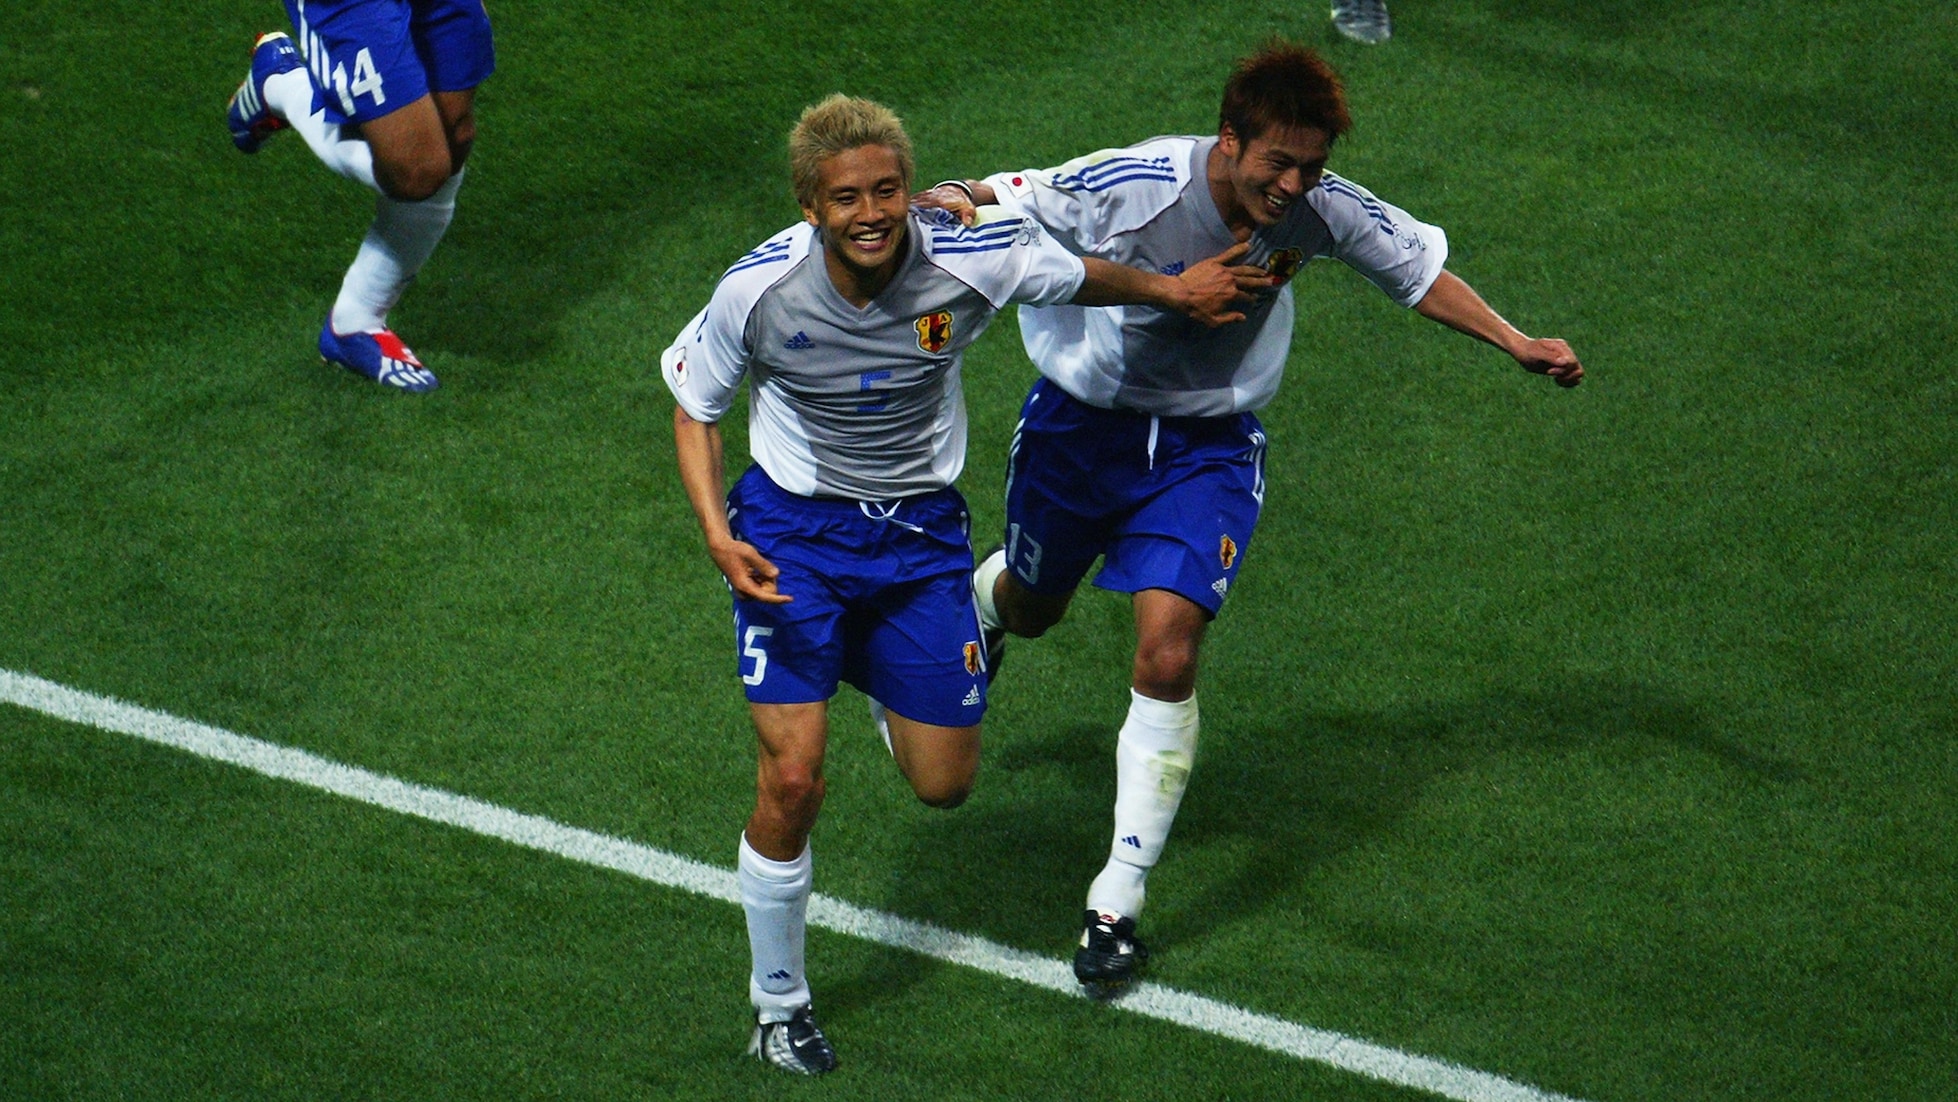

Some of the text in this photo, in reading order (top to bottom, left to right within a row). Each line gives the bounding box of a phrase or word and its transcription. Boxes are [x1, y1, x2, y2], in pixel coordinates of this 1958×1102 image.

[332, 46, 386, 117] 14
[1008, 522, 1043, 585] 13
[742, 625, 774, 687] 5
